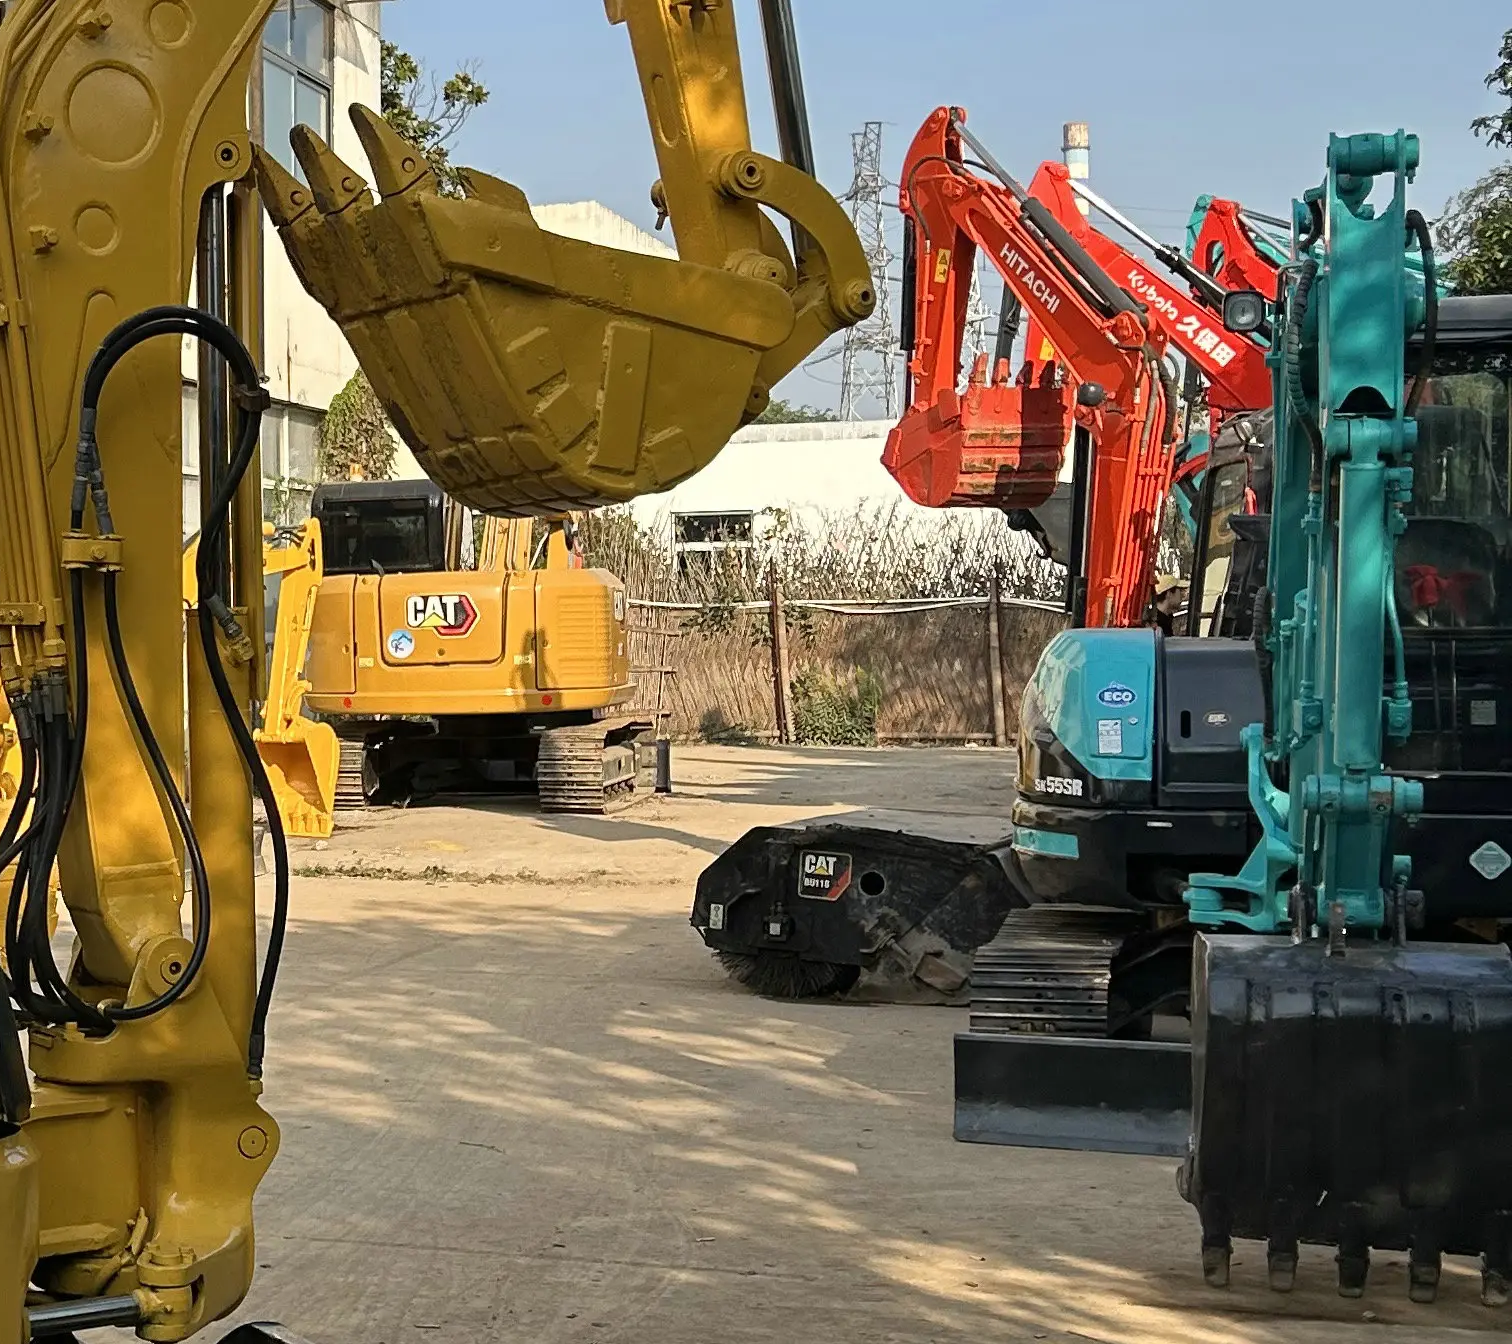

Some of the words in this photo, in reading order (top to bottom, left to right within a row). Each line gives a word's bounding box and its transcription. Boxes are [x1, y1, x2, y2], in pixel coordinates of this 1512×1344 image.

[999, 242, 1061, 314] HITACHI
[1127, 268, 1179, 321] Kubota
[1176, 314, 1236, 367] 久保田
[406, 594, 460, 627] CAT
[1103, 691, 1134, 703] ECO
[804, 854, 837, 876] CAT
